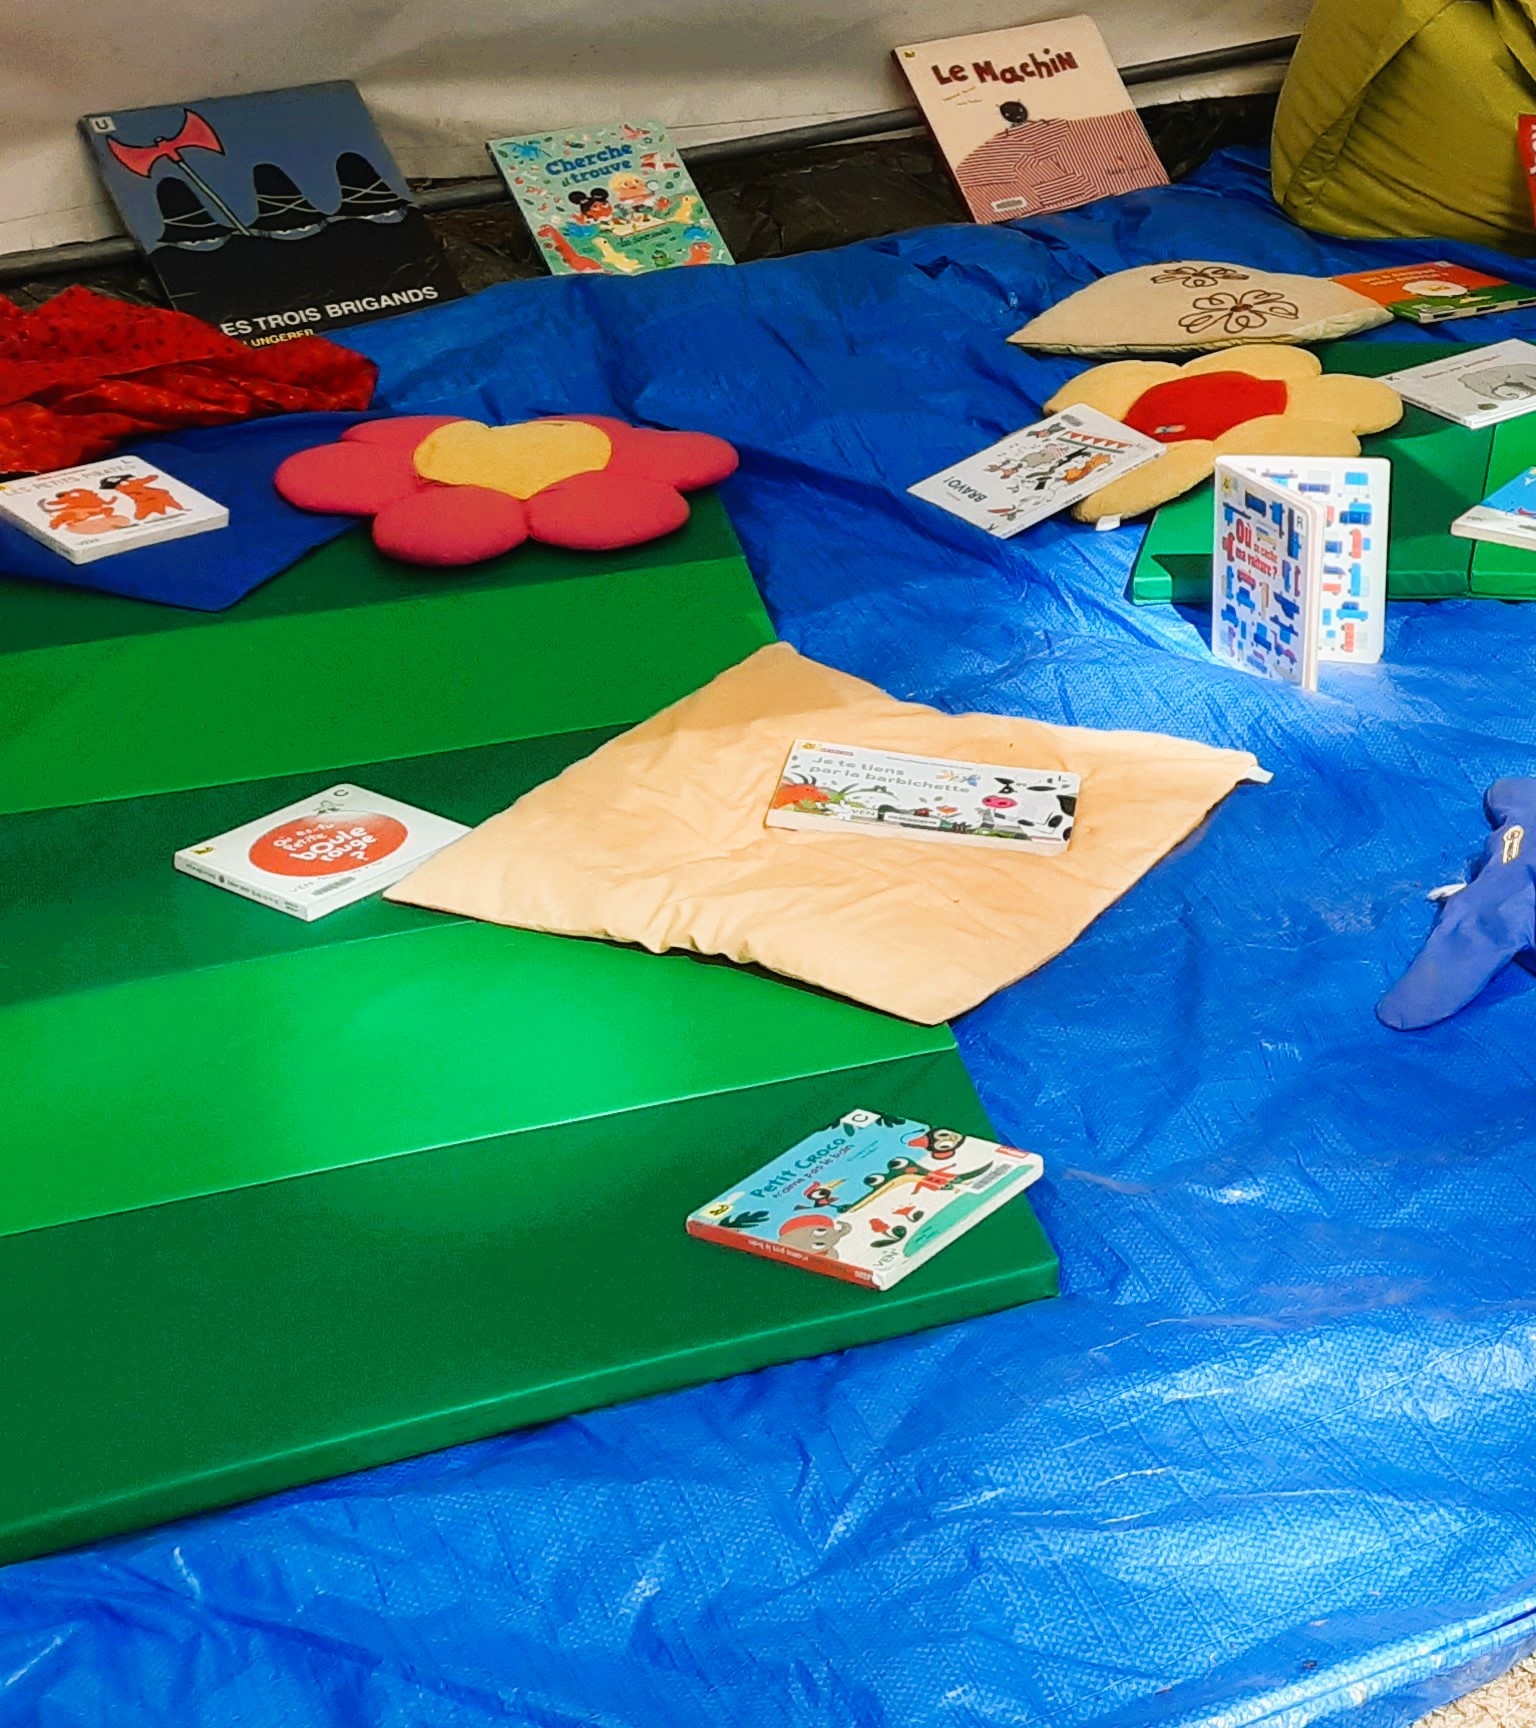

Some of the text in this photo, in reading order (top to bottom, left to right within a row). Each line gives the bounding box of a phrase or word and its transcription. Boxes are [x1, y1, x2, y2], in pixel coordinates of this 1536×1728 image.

[931, 62, 969, 85] Le
[94, 118, 110, 131] U
[545, 143, 634, 176] Cherche
[570, 158, 633, 184] trouve
[220, 286, 439, 337] ES TROIS BRIGANDS
[1523, 476, 1536, 487] Y
[1296, 515, 1303, 530] R
[1235, 546, 1246, 562] ma
[812, 756, 833, 765] Je
[837, 759, 856, 769] te
[861, 763, 905, 776] tiens
[809, 765, 970, 794] par la barbichette
[332, 788, 350, 798] C
[320, 834, 379, 863] rouge
[852, 1113, 868, 1123] C
